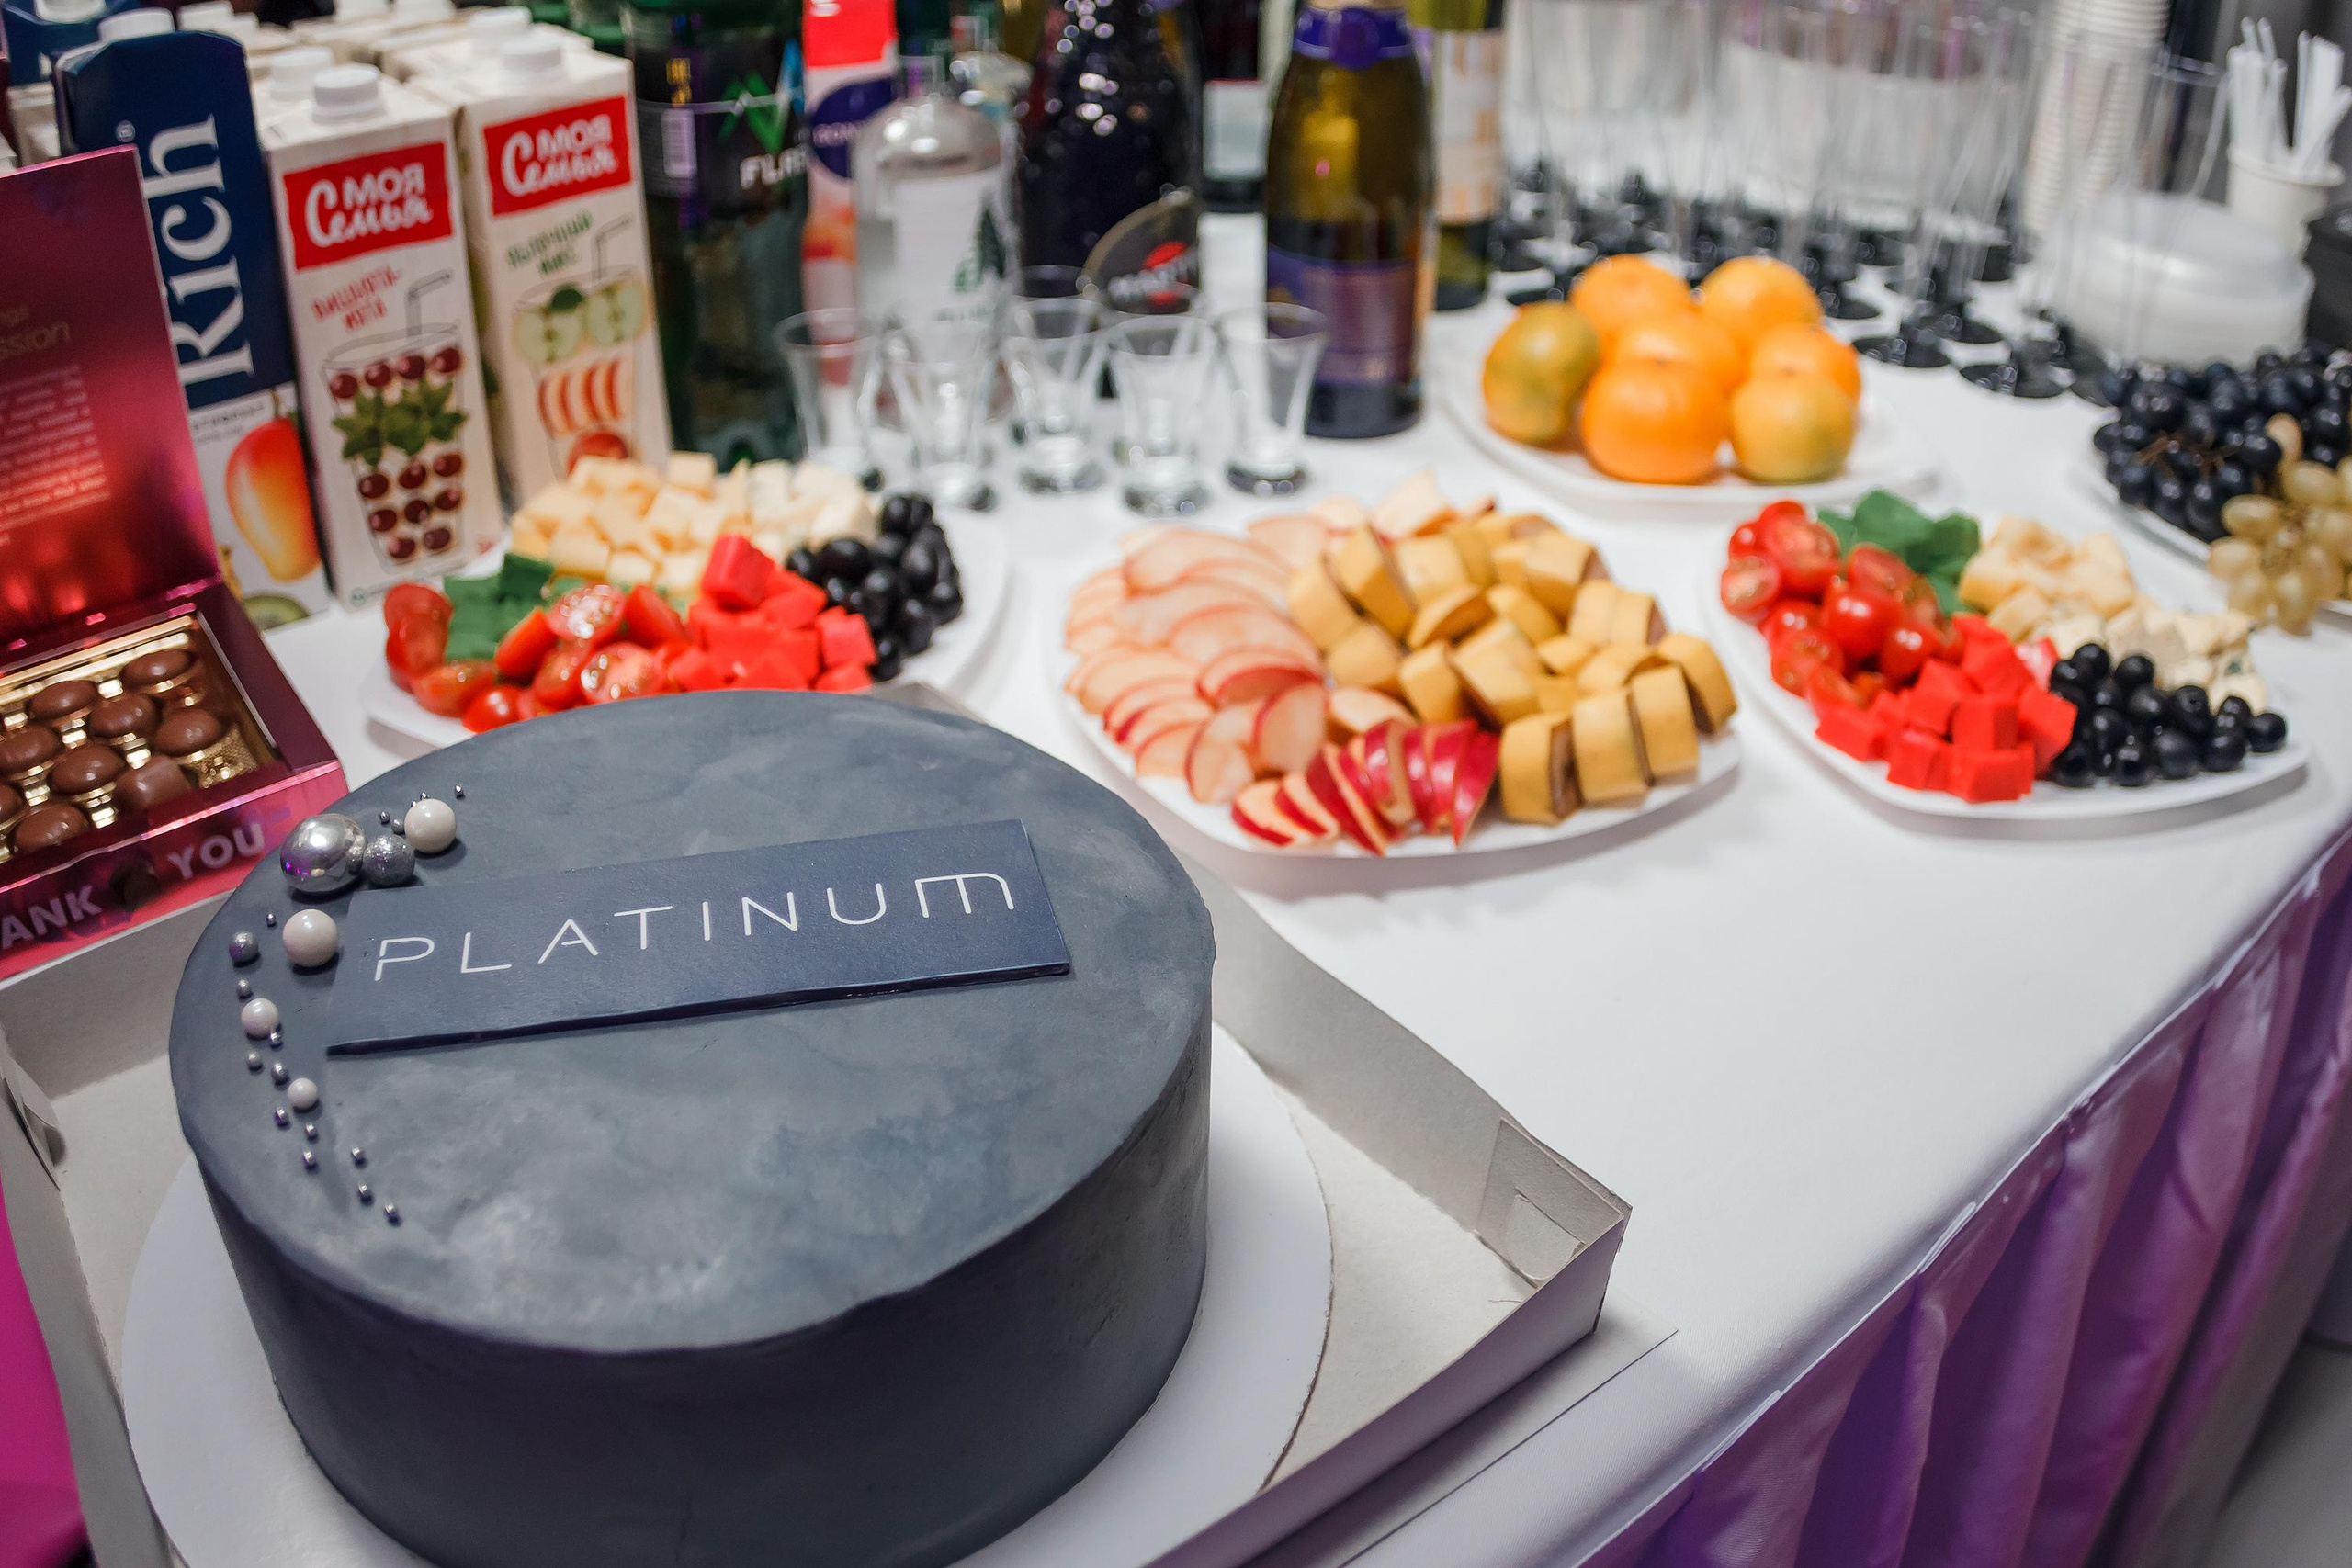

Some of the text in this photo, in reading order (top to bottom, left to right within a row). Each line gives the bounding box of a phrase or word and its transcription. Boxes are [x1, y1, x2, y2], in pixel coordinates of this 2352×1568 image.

[501, 130, 619, 197] Семья
[142, 113, 254, 378] Rich
[305, 179, 435, 248] Семья
[167, 822, 266, 881] YOU
[374, 871, 1015, 981] PLATINUM
